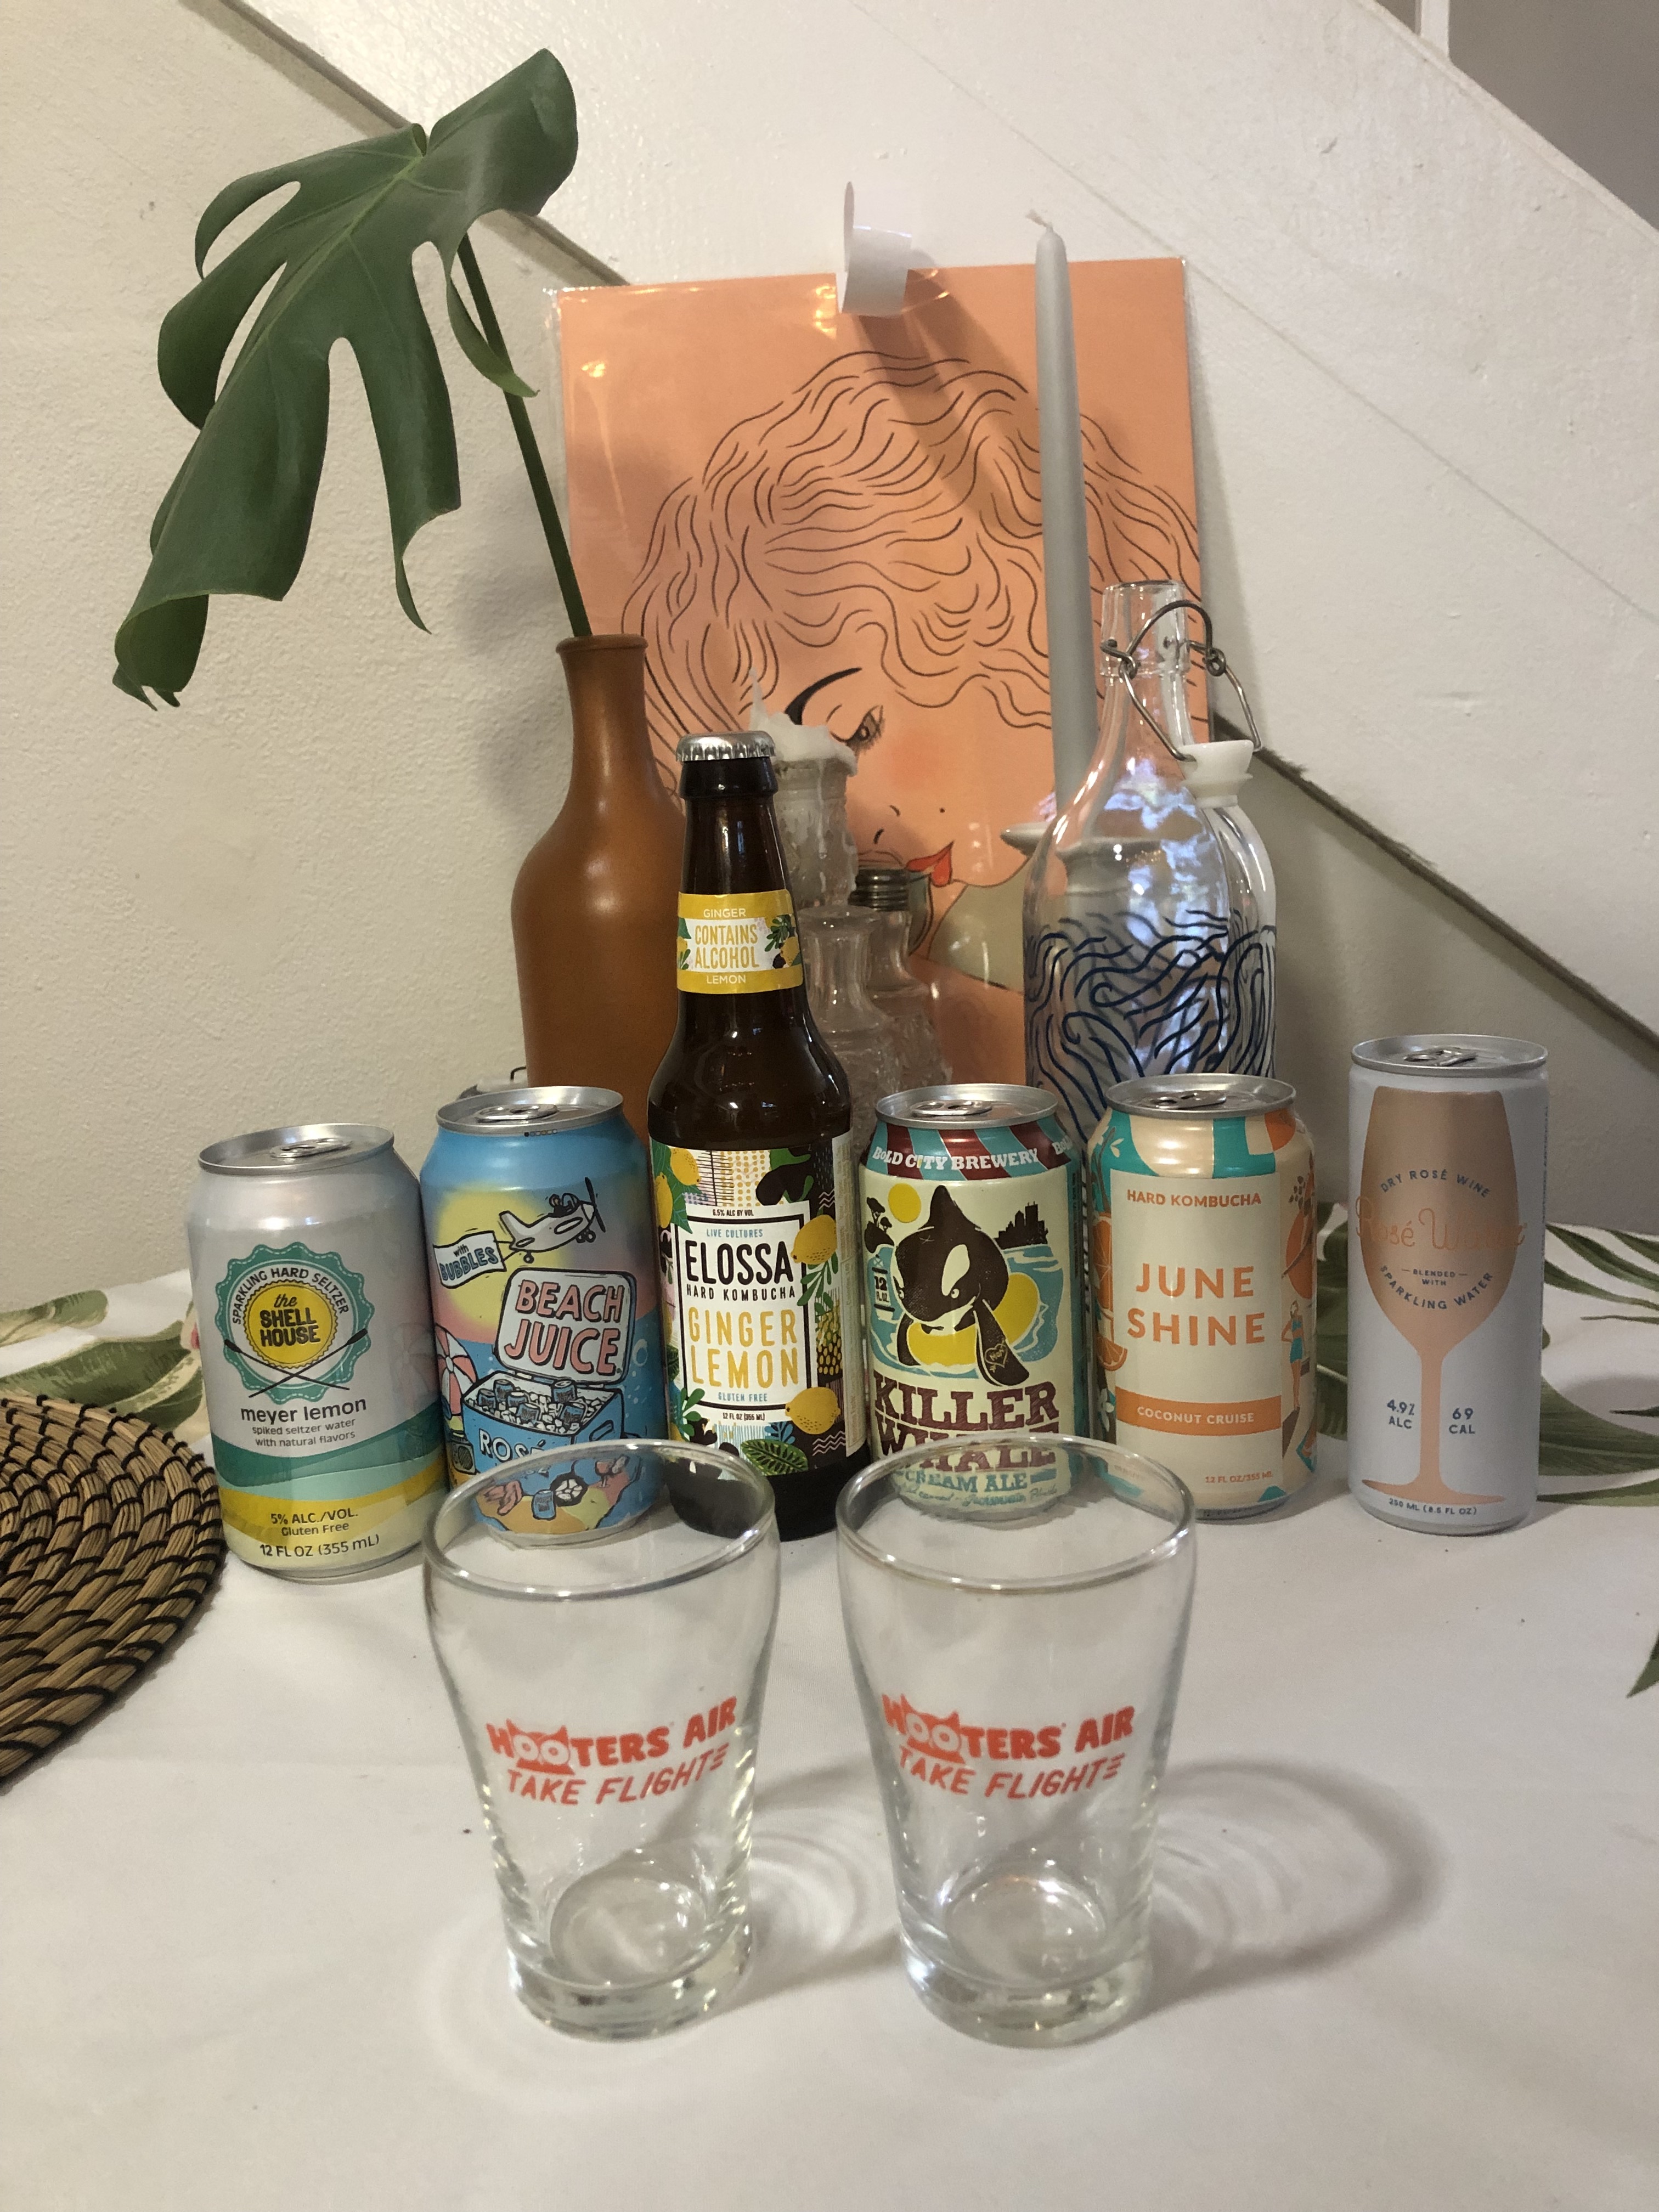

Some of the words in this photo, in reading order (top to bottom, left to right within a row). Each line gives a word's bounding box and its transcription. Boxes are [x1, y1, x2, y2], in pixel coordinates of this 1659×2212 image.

[703, 908, 747, 918] GINGER
[695, 924, 759, 945] CONTAINS
[695, 946, 760, 969] ALCOHOL
[706, 974, 747, 984] LEMON
[872, 1146, 904, 1165] BOLD
[905, 1154, 948, 1170] CITY
[950, 1148, 1040, 1170] BREWERY
[1380, 1173, 1403, 1193] DRY
[1408, 1169, 1448, 1181] ROSÉ
[1457, 1174, 1491, 1198] WINE
[1127, 1189, 1166, 1205] HARD
[1171, 1192, 1262, 1207] KOMBUCHA
[706, 1228, 722, 1238] LIVE
[725, 1228, 764, 1238] CULTURES
[453, 1244, 470, 1257] with
[439, 1246, 499, 1282] BUBBLES
[685, 1239, 794, 1285] ELOSSA
[1413, 1268, 1456, 1278] BLENDED
[873, 1276, 888, 1291] 12
[1135, 1263, 1254, 1299] JUNE
[1379, 1265, 1448, 1310] SPARKLING
[1453, 1272, 1494, 1306] WATER
[233, 1271, 268, 1325] SPARKLING
[270, 1267, 309, 1279] HARD
[312, 1273, 349, 1314] SELTZER
[273, 1293, 298, 1308] the
[515, 1279, 625, 1323] BEACH
[686, 1284, 714, 1300] HARD
[723, 1285, 795, 1301] KOMBUCHA
[259, 1307, 317, 1328] SHELL
[689, 1307, 798, 1347] GINGER
[1127, 1307, 1265, 1346] SHINE
[259, 1325, 321, 1347] HOUSE
[504, 1318, 622, 1376] JUICE
[691, 1345, 799, 1389] LEMON
[718, 1392, 745, 1401] GLUTEN
[749, 1393, 768, 1402] FREE
[873, 1371, 1059, 1431] KILLER
[1386, 1399, 1415, 1416] 4.9%
[240, 1408, 298, 1425] meyer
[303, 1398, 367, 1421] lemon
[1137, 1406, 1202, 1424] COCONUT
[1206, 1413, 1255, 1425] CRUISE
[1389, 1415, 1413, 1429] ALC
[1452, 1407, 1474, 1420] 69
[252, 1426, 283, 1436] spiked
[285, 1425, 321, 1435] seltzer
[325, 1418, 356, 1431] water
[1448, 1424, 1476, 1435] CAL
[255, 1437, 276, 1447] with
[279, 1437, 317, 1447] natural
[319, 1431, 356, 1444] flavors
[479, 1427, 547, 1463] ROS
[905, 1470, 978, 1493] CREAM
[984, 1472, 1028, 1493] ALE
[1389, 1498, 1404, 1508] 250
[1406, 1502, 1419, 1511] ML
[1459, 1506, 1477, 1516] OZ)
[270, 1513, 289, 1525] 5%
[281, 1527, 319, 1536] Gluten
[323, 1522, 350, 1534] Free
[259, 1544, 273, 1556] 12
[275, 1545, 292, 1557] FL
[294, 1545, 314, 1557] OZ
[318, 1541, 349, 1556] (355
[352, 1533, 380, 1551] mL)
[486, 1718, 670, 1775] HOOTERS
[683, 1696, 738, 1749] AIR
[882, 1693, 1063, 1764] HOOTERS
[1074, 1705, 1135, 1753] AIR
[899, 1745, 977, 1795] TAKE
[507, 1769, 586, 1805] TAKE
